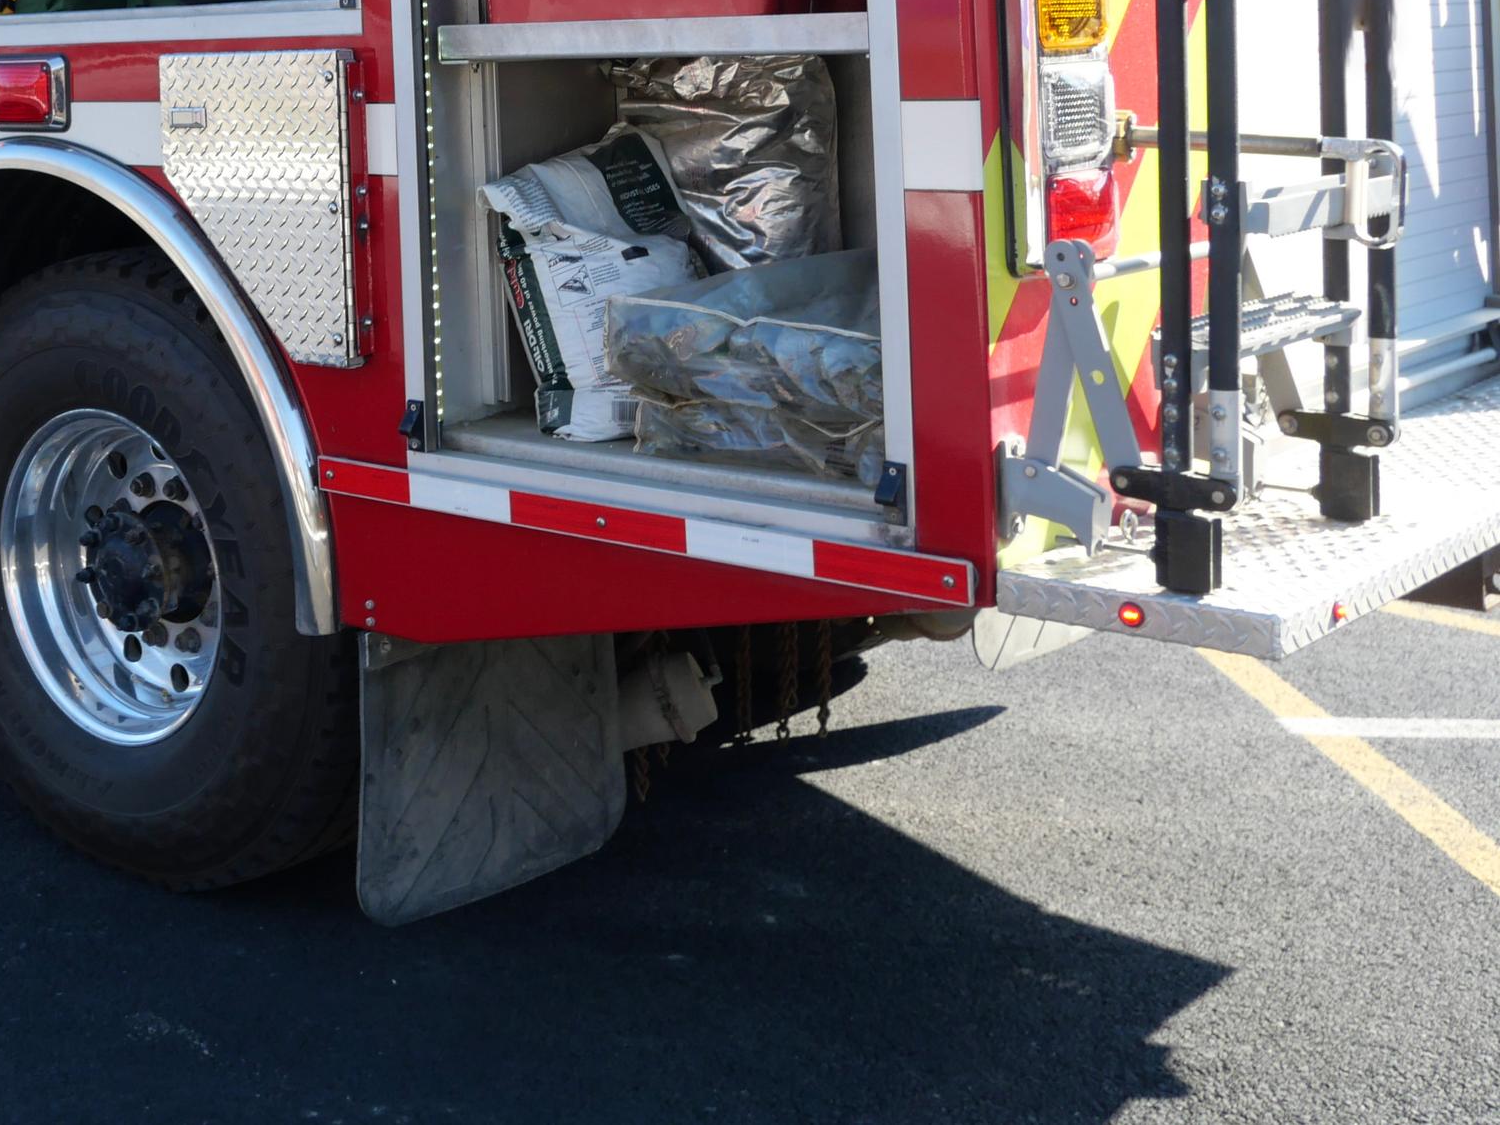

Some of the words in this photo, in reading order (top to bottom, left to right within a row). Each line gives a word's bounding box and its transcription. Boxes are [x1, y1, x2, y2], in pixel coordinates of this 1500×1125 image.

[520, 278, 527, 289] 40
[528, 301, 541, 328] power
[72, 357, 250, 691] GOODYEAR
